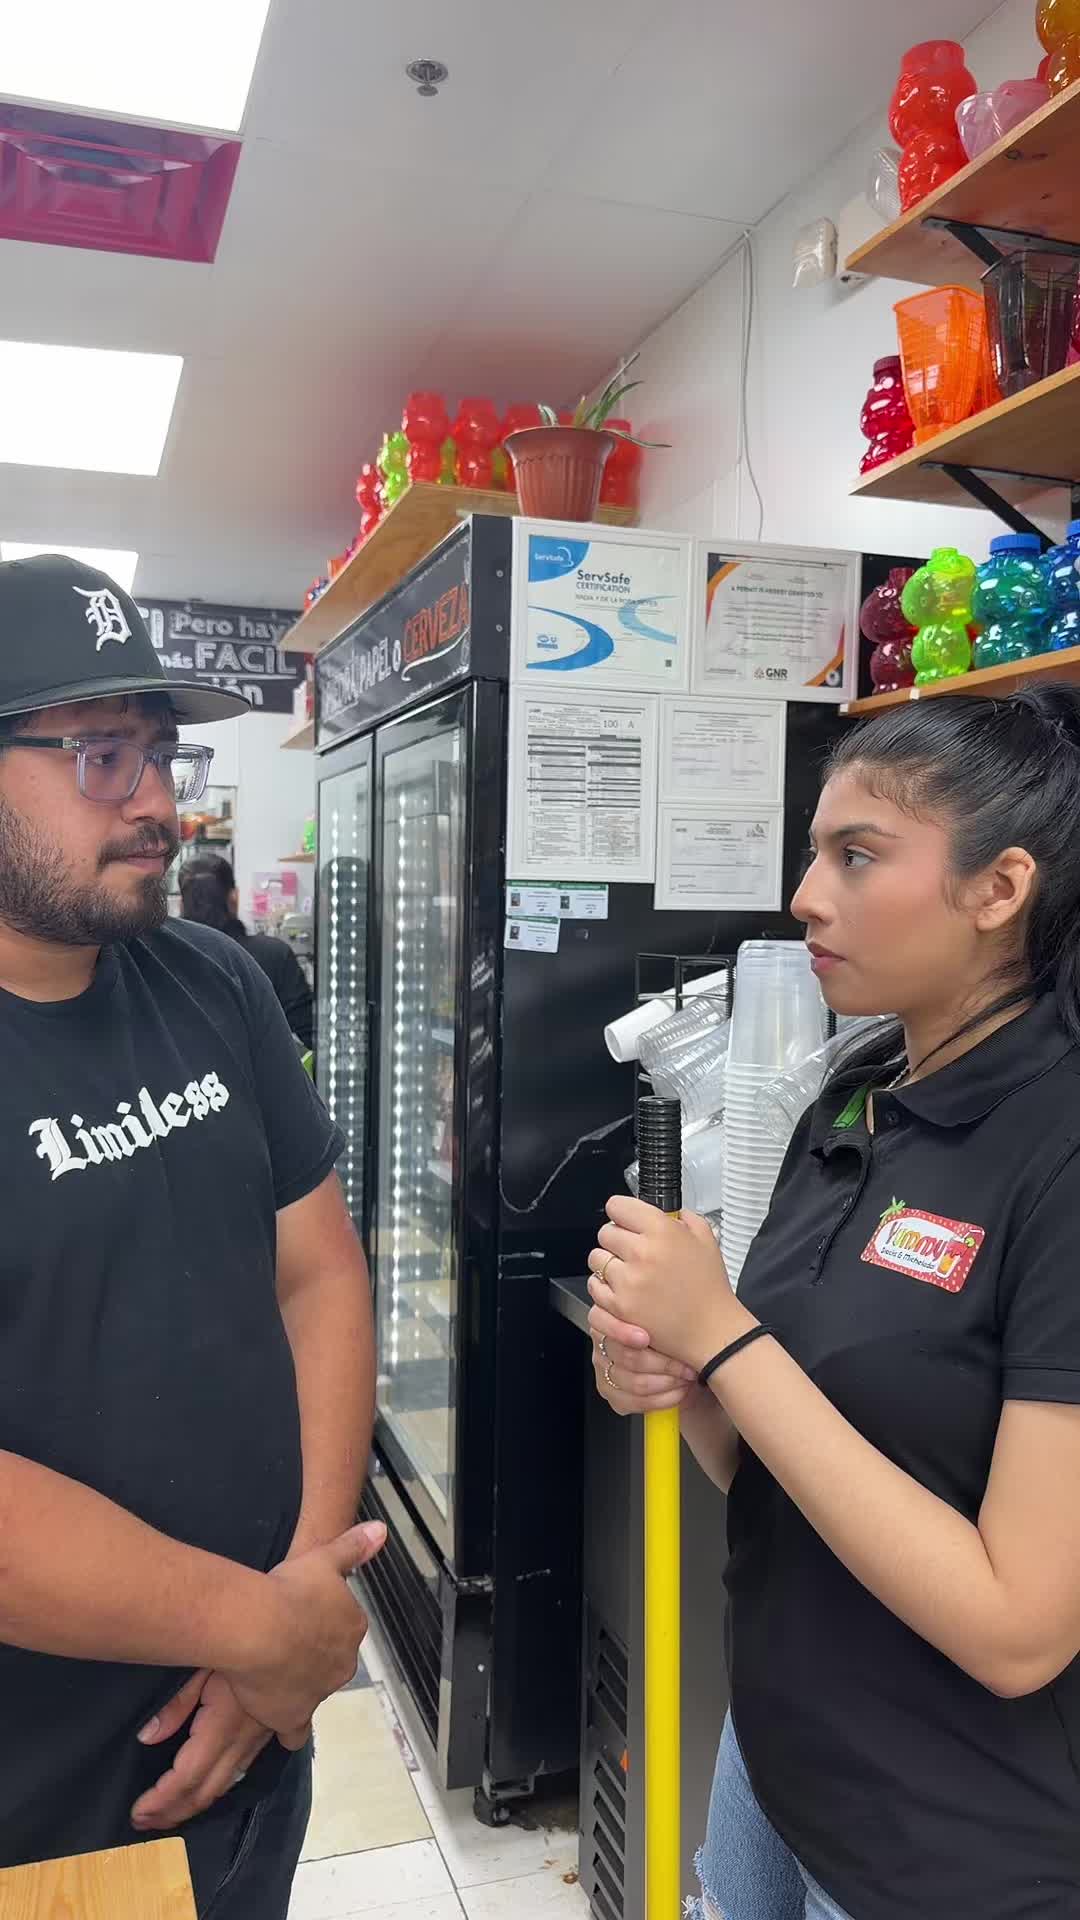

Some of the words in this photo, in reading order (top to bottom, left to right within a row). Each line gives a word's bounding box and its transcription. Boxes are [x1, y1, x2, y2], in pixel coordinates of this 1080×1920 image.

[575, 581, 630, 594] CERTIFICATION
[577, 569, 631, 585] ServSafe
[73, 586, 132, 651] D
[175, 613, 234, 636] Pero
[239, 615, 287, 645] hay
[359, 636, 392, 694] PAPEL
[403, 584, 470, 664] CERVEZA
[195, 641, 297, 675] FACIL
[766, 667, 788, 678] GNR
[603, 719, 618, 728] 100
[627, 720, 634, 728] A
[885, 1221, 947, 1262] Yummy
